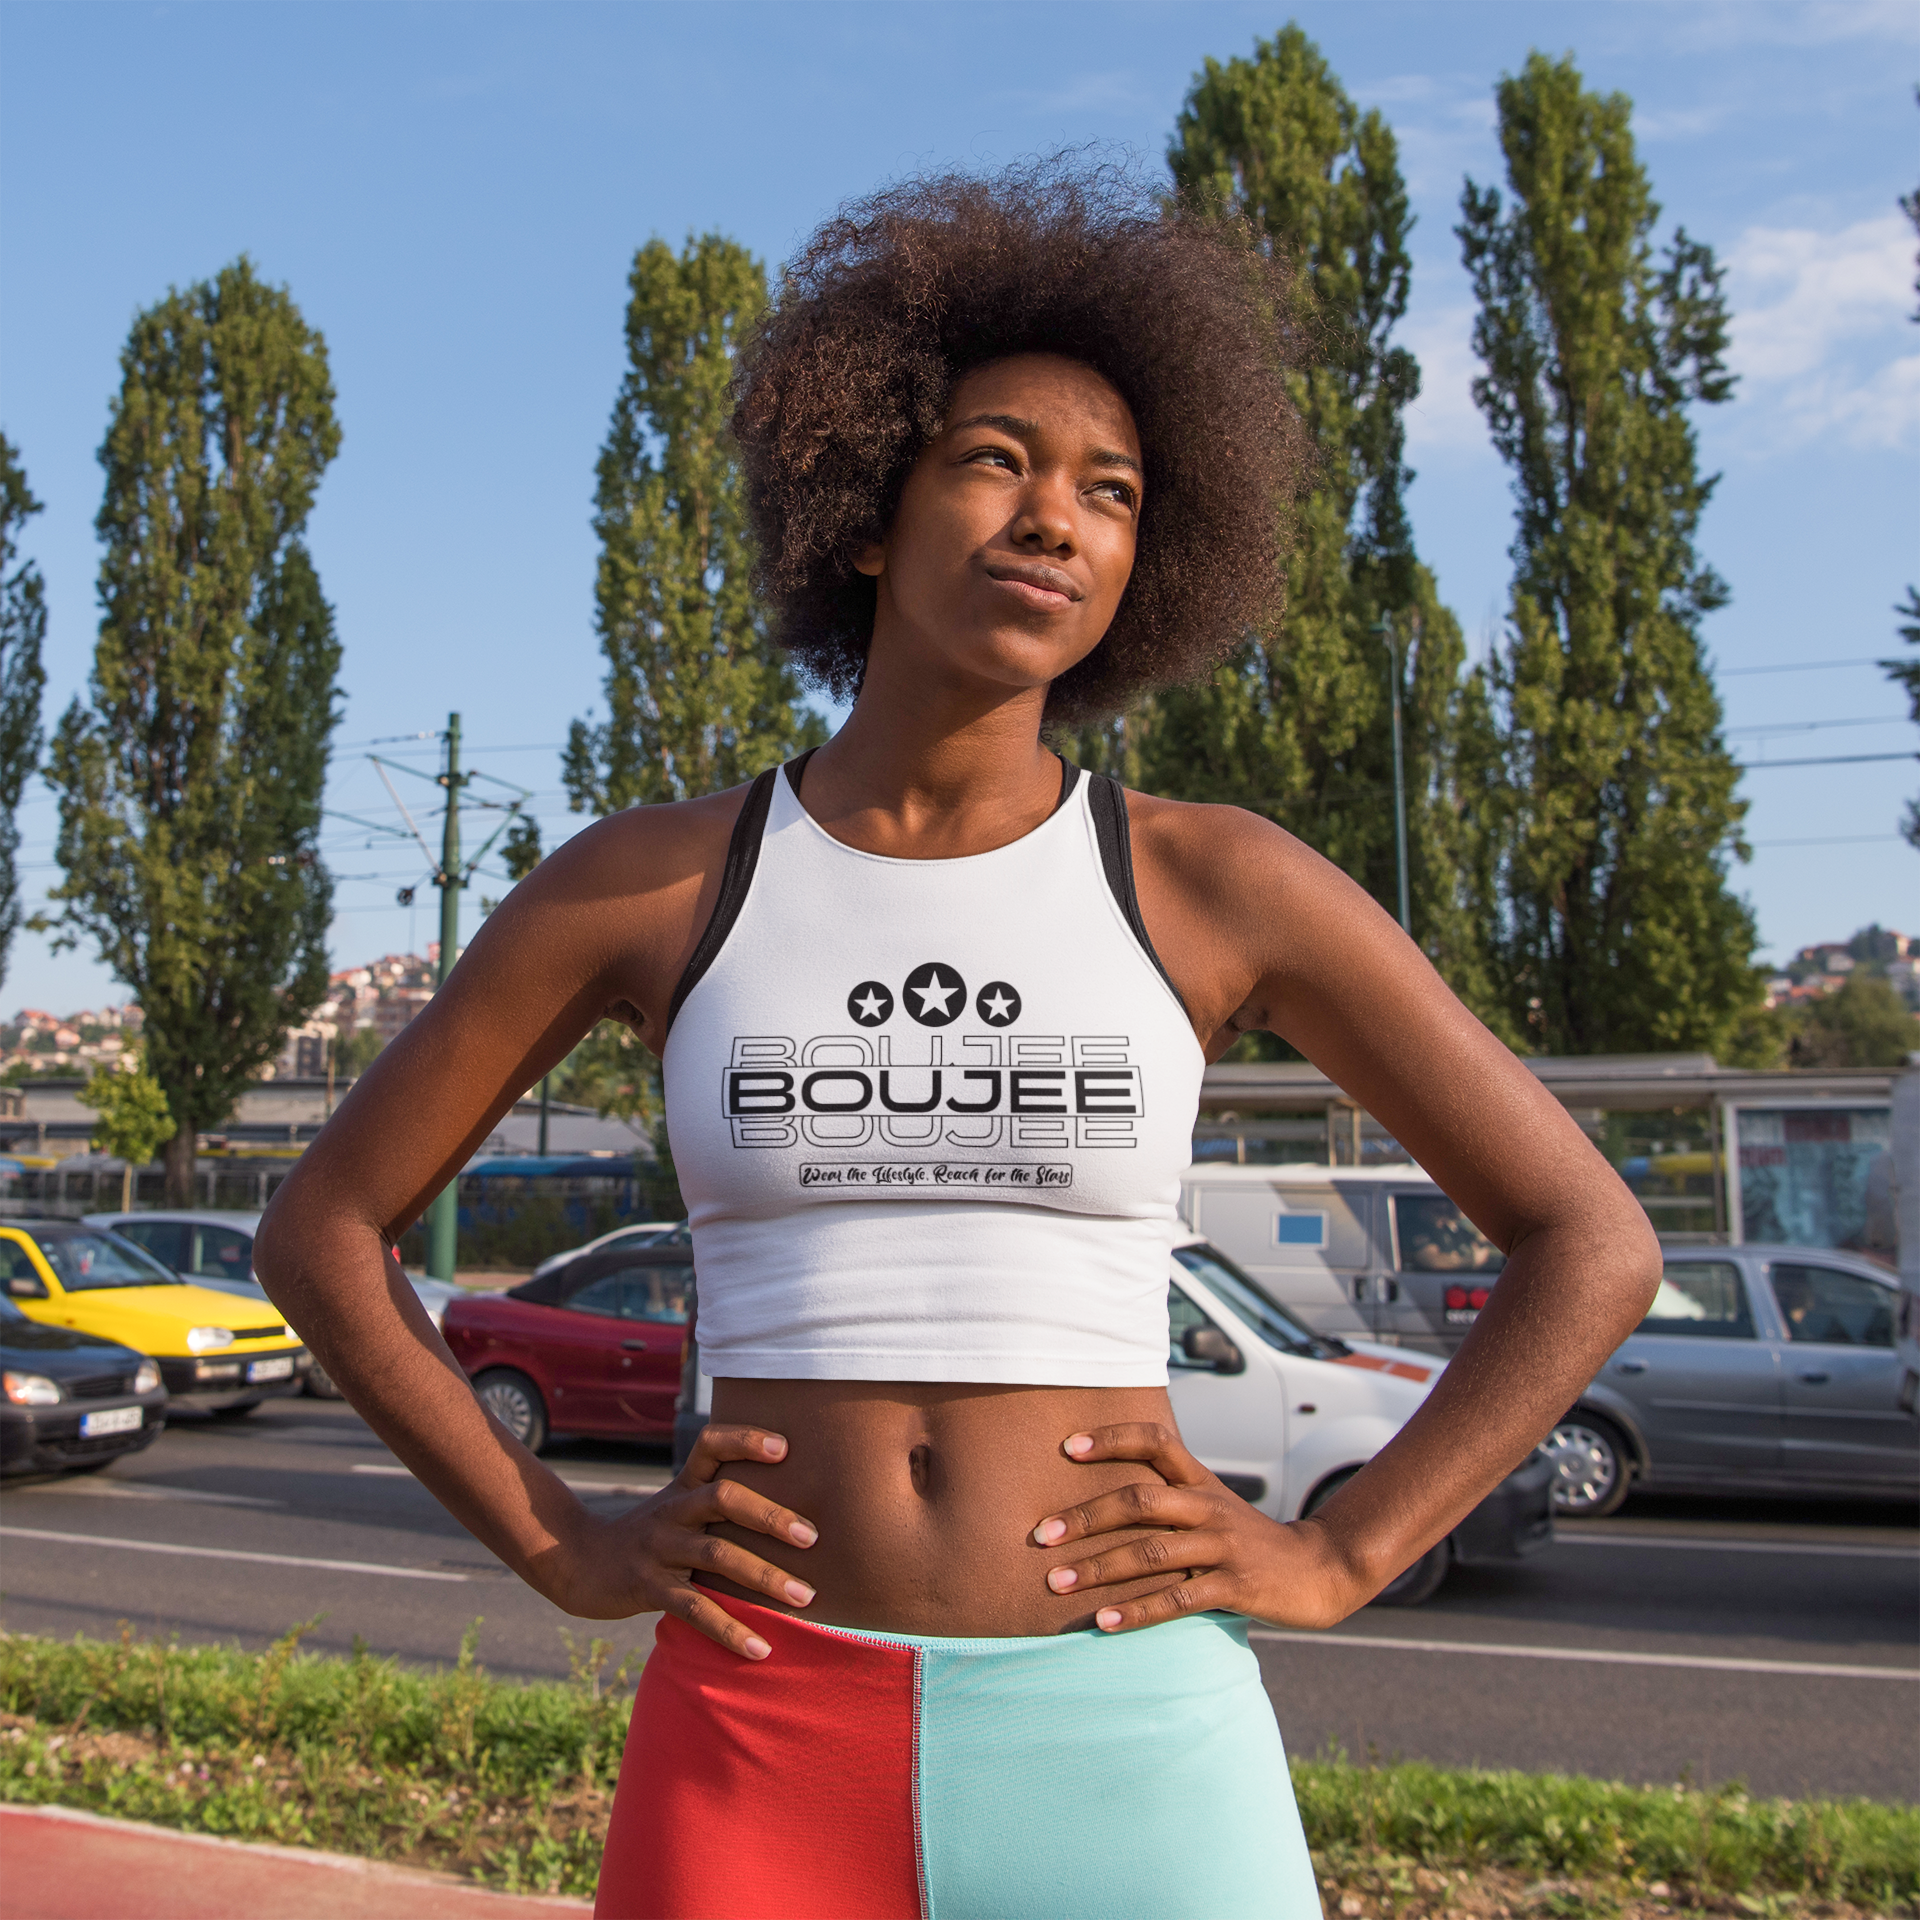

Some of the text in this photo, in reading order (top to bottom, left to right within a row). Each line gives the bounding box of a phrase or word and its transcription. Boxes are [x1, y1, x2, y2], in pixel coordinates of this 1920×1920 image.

[729, 1070, 1137, 1115] BOUJEE
[802, 1167, 842, 1185] Wear
[846, 1167, 867, 1182] the
[932, 1164, 979, 1184] Reach
[984, 1167, 1006, 1184] for
[1010, 1167, 1030, 1183] the
[1035, 1165, 1070, 1185] Stars
